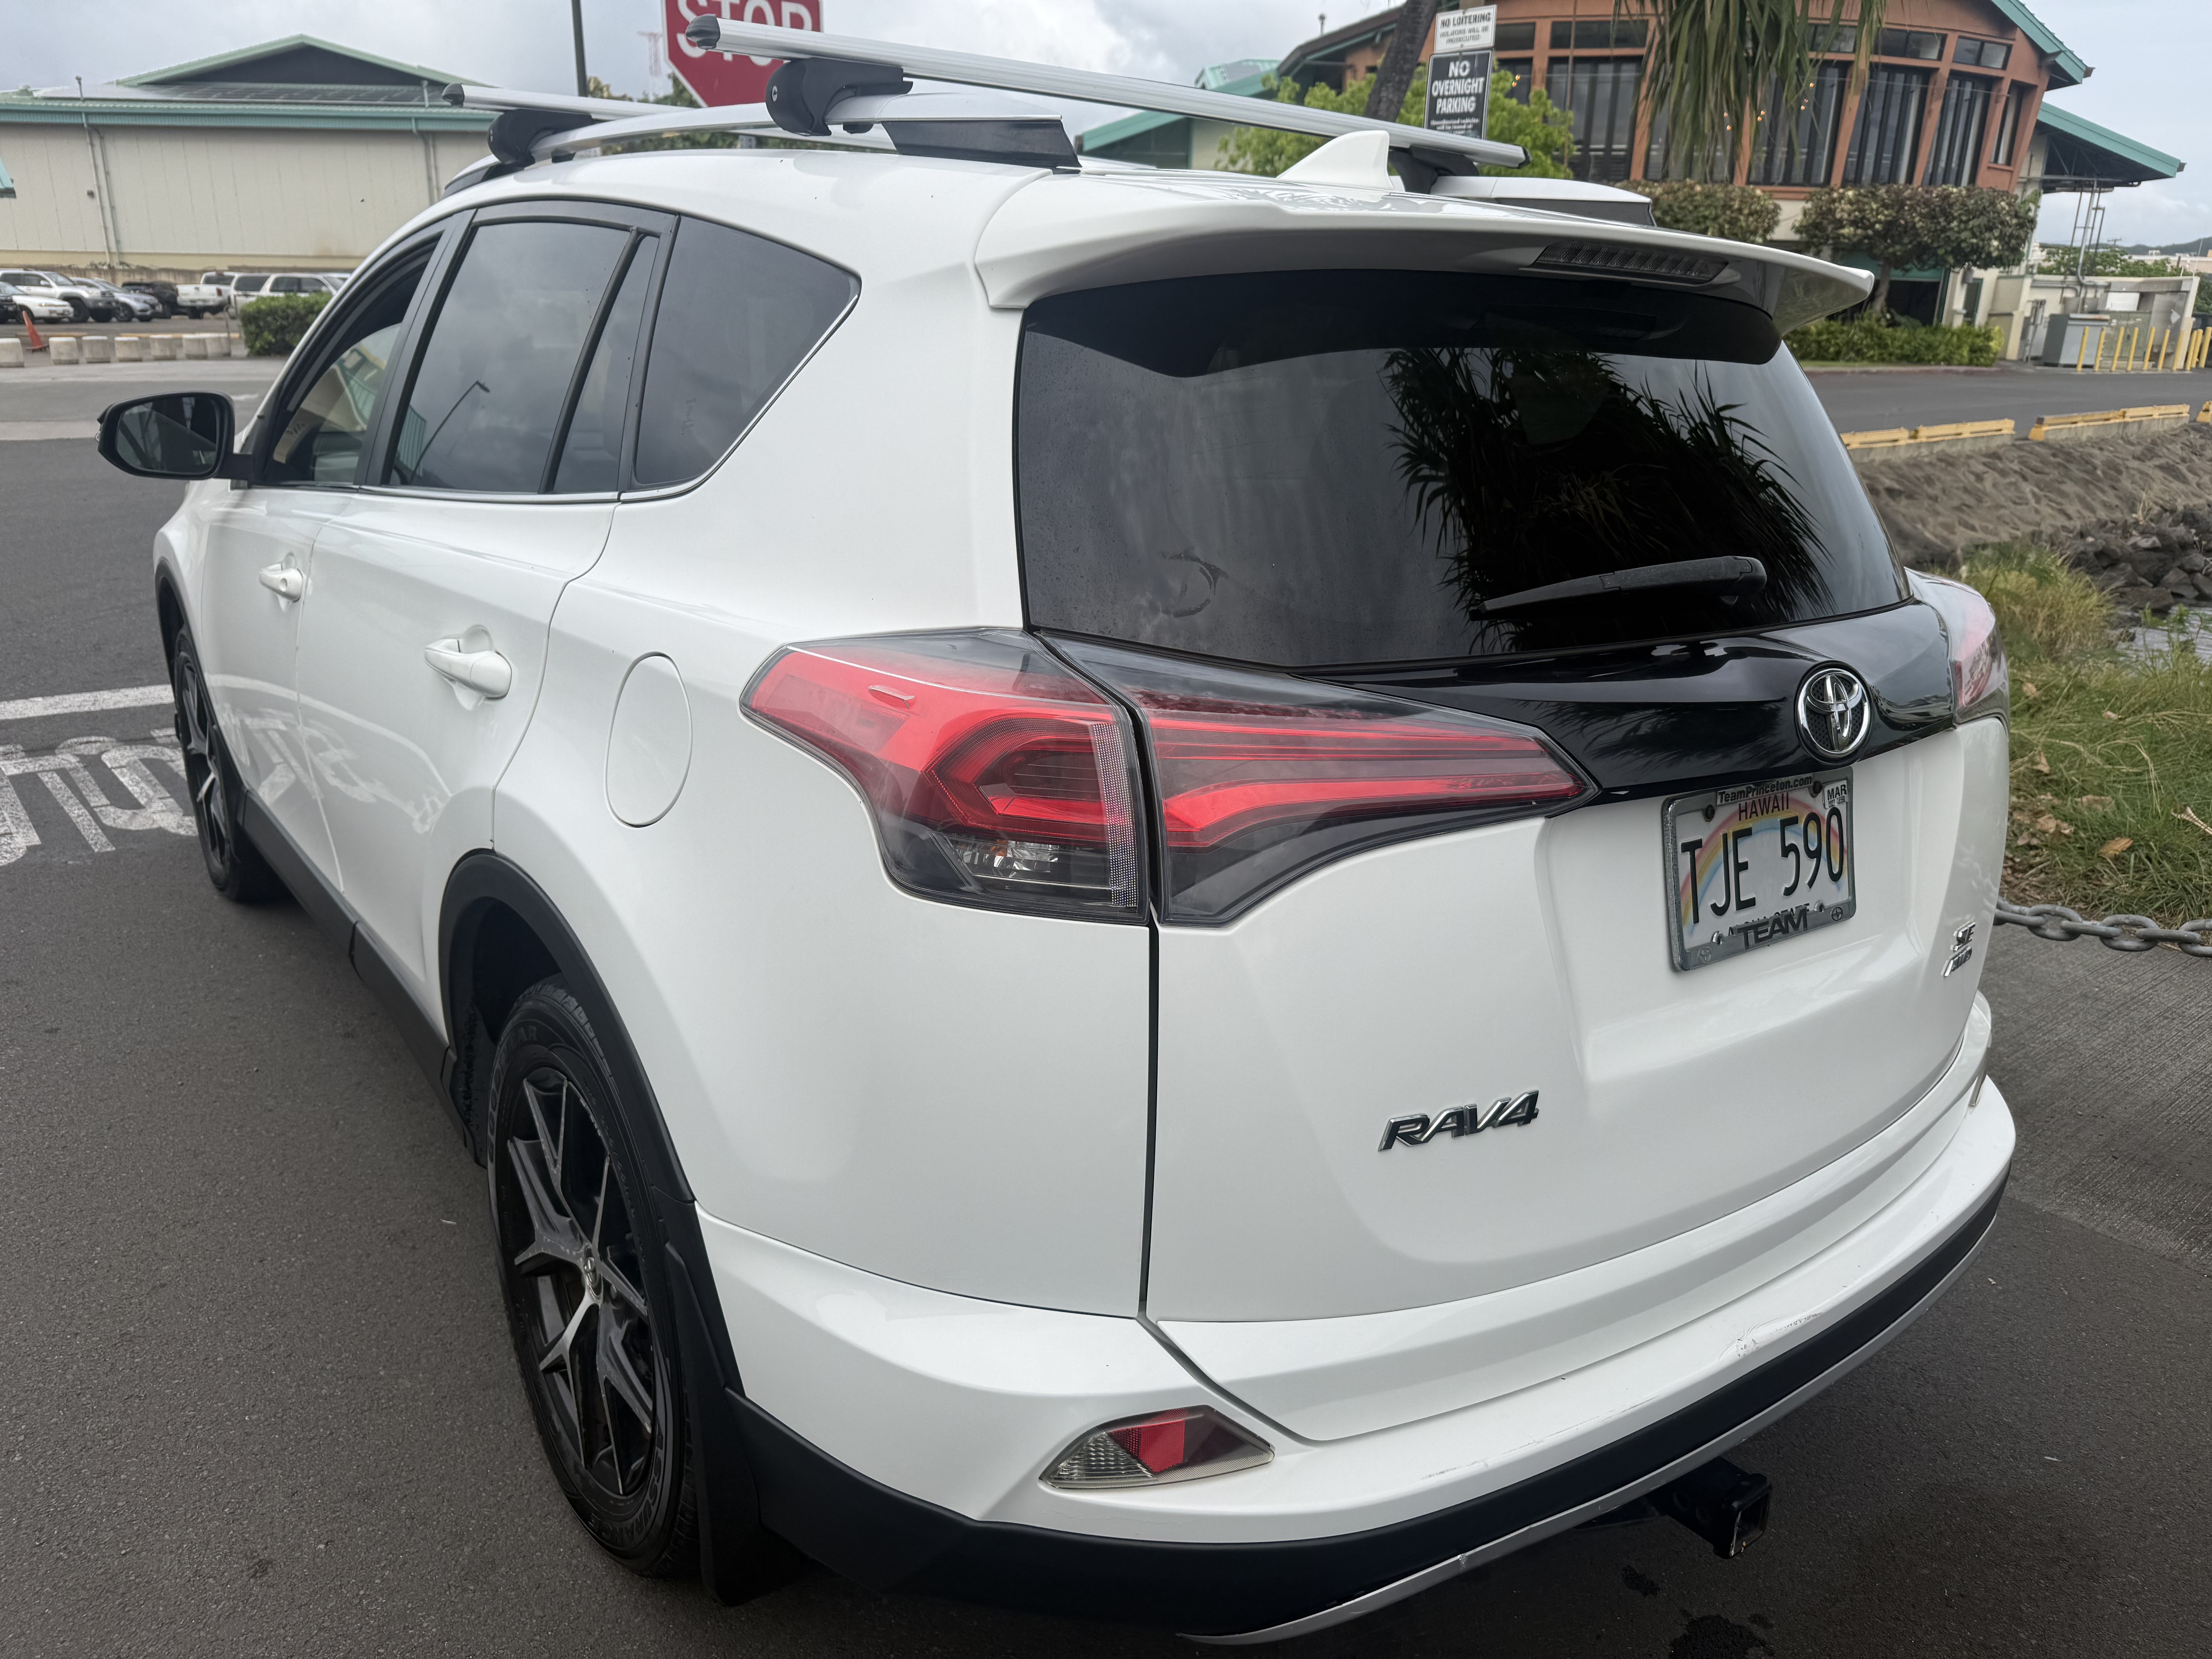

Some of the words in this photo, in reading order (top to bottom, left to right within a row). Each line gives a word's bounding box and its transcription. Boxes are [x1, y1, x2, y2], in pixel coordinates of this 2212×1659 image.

[1441, 18, 1450, 28] NO
[1452, 12, 1491, 26] LOITERING
[1448, 60, 1470, 77] NO
[1432, 77, 1485, 96] OVERNIGHT
[1436, 96, 1477, 115] PARKING
[1718, 776, 1813, 803] TeamPrinceton.com
[1827, 784, 1847, 801] MAR
[1738, 792, 1789, 821] HAWAII
[1681, 826, 1756, 924] TJE
[1779, 807, 1844, 896] 590
[1735, 905, 1808, 950] TEAM
[1378, 1089, 1539, 1152] RAV4
